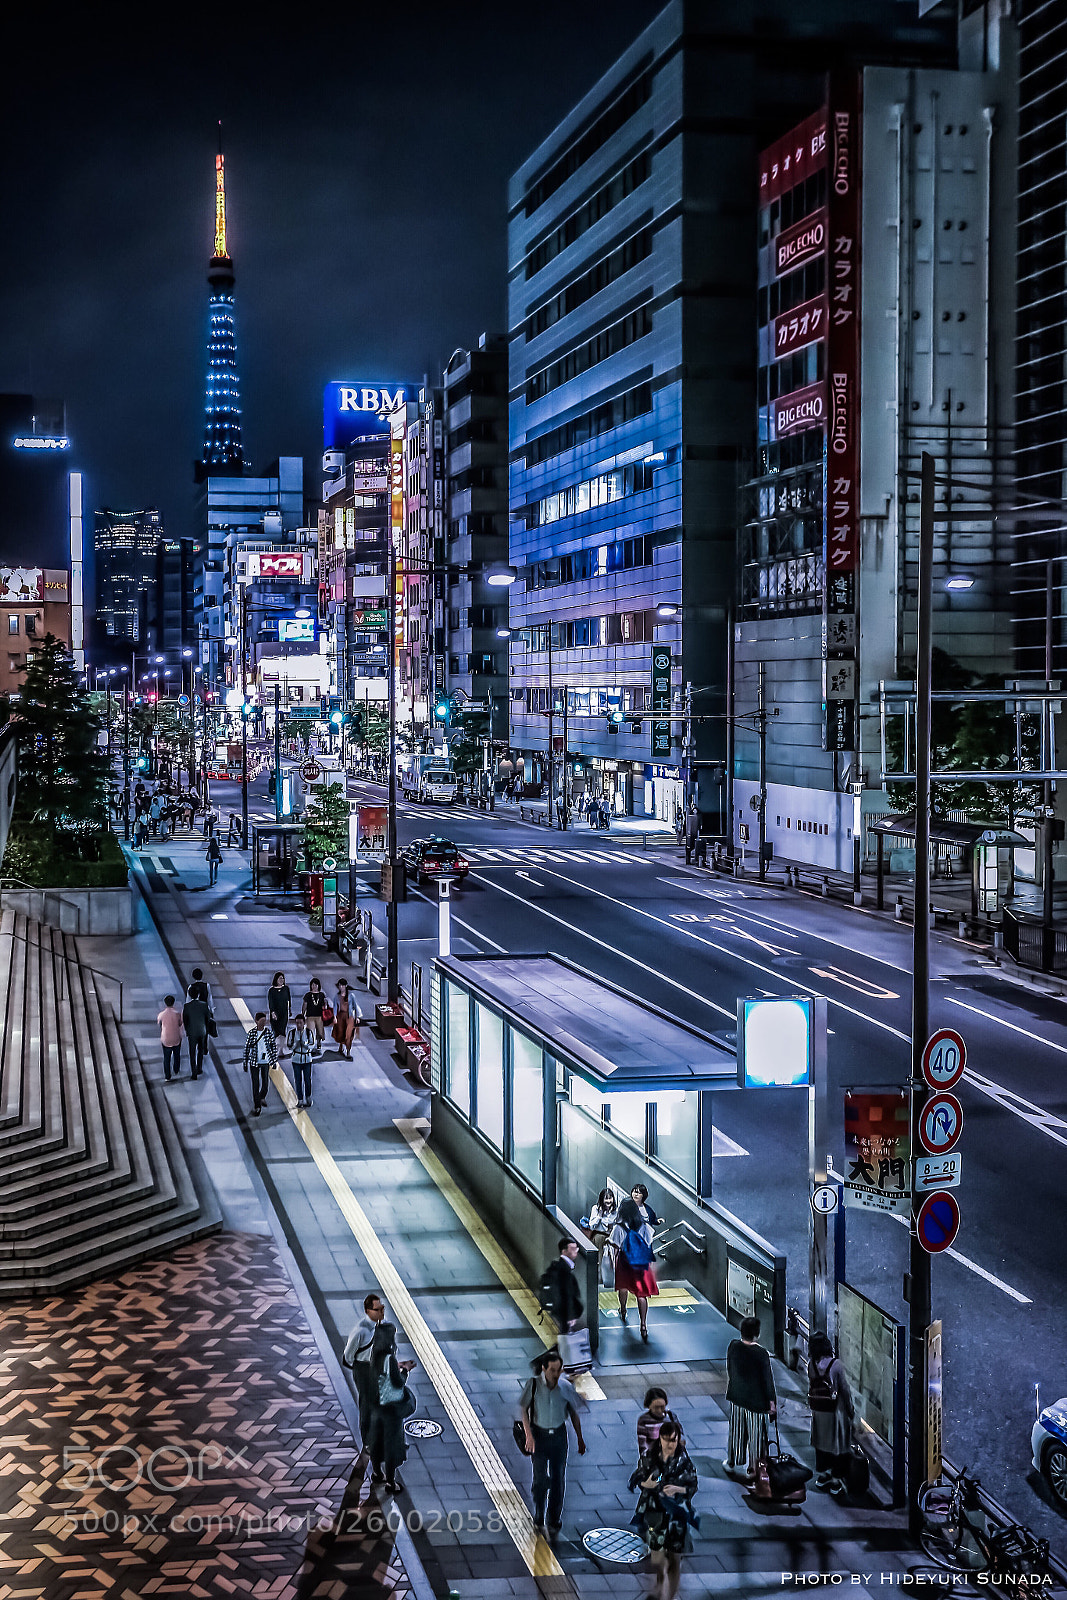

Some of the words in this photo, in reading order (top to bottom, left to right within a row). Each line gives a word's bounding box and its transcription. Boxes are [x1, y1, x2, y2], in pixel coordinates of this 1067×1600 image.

[834, 112, 849, 143] BIG
[760, 147, 804, 187] カラオケ
[834, 150, 849, 195] ECHO
[778, 239, 796, 267] BIG
[797, 224, 824, 251] ECHO
[833, 235, 852, 325] カラオケ
[777, 308, 823, 346] カラオケ
[339, 387, 405, 411] RBM
[833, 373, 847, 404] BIG
[778, 407, 795, 431] BIG
[796, 397, 823, 419] ECHO
[833, 408, 847, 453] ECHO
[832, 477, 851, 565] カラオケ
[261, 558, 301, 570] アイフル
[359, 834, 385, 849] 大門
[932, 1047, 957, 1074] 40
[848, 1154, 906, 1191] 大門
